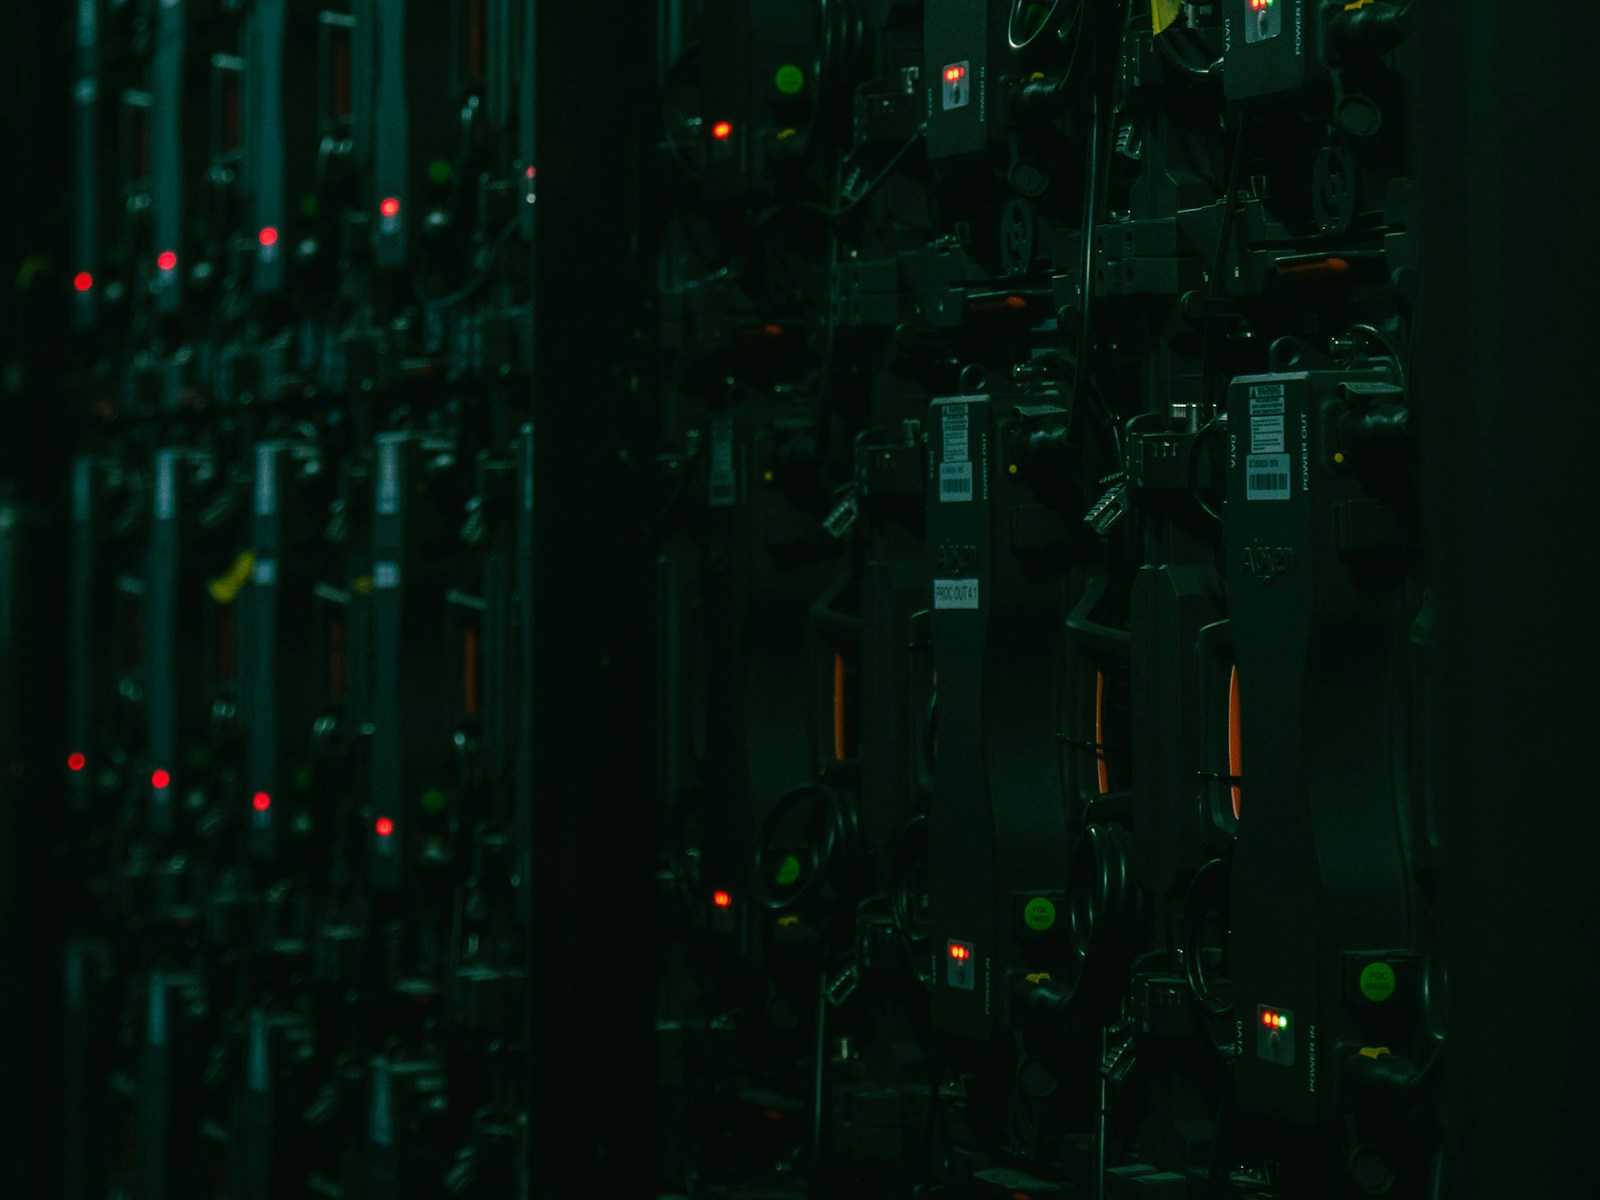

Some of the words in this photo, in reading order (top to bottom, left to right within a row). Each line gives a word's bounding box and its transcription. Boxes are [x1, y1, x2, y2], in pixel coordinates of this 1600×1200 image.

[954, 585, 967, 601] OUT
[1366, 981, 1391, 992] PASS
[1309, 1025, 1316, 1039] IN
